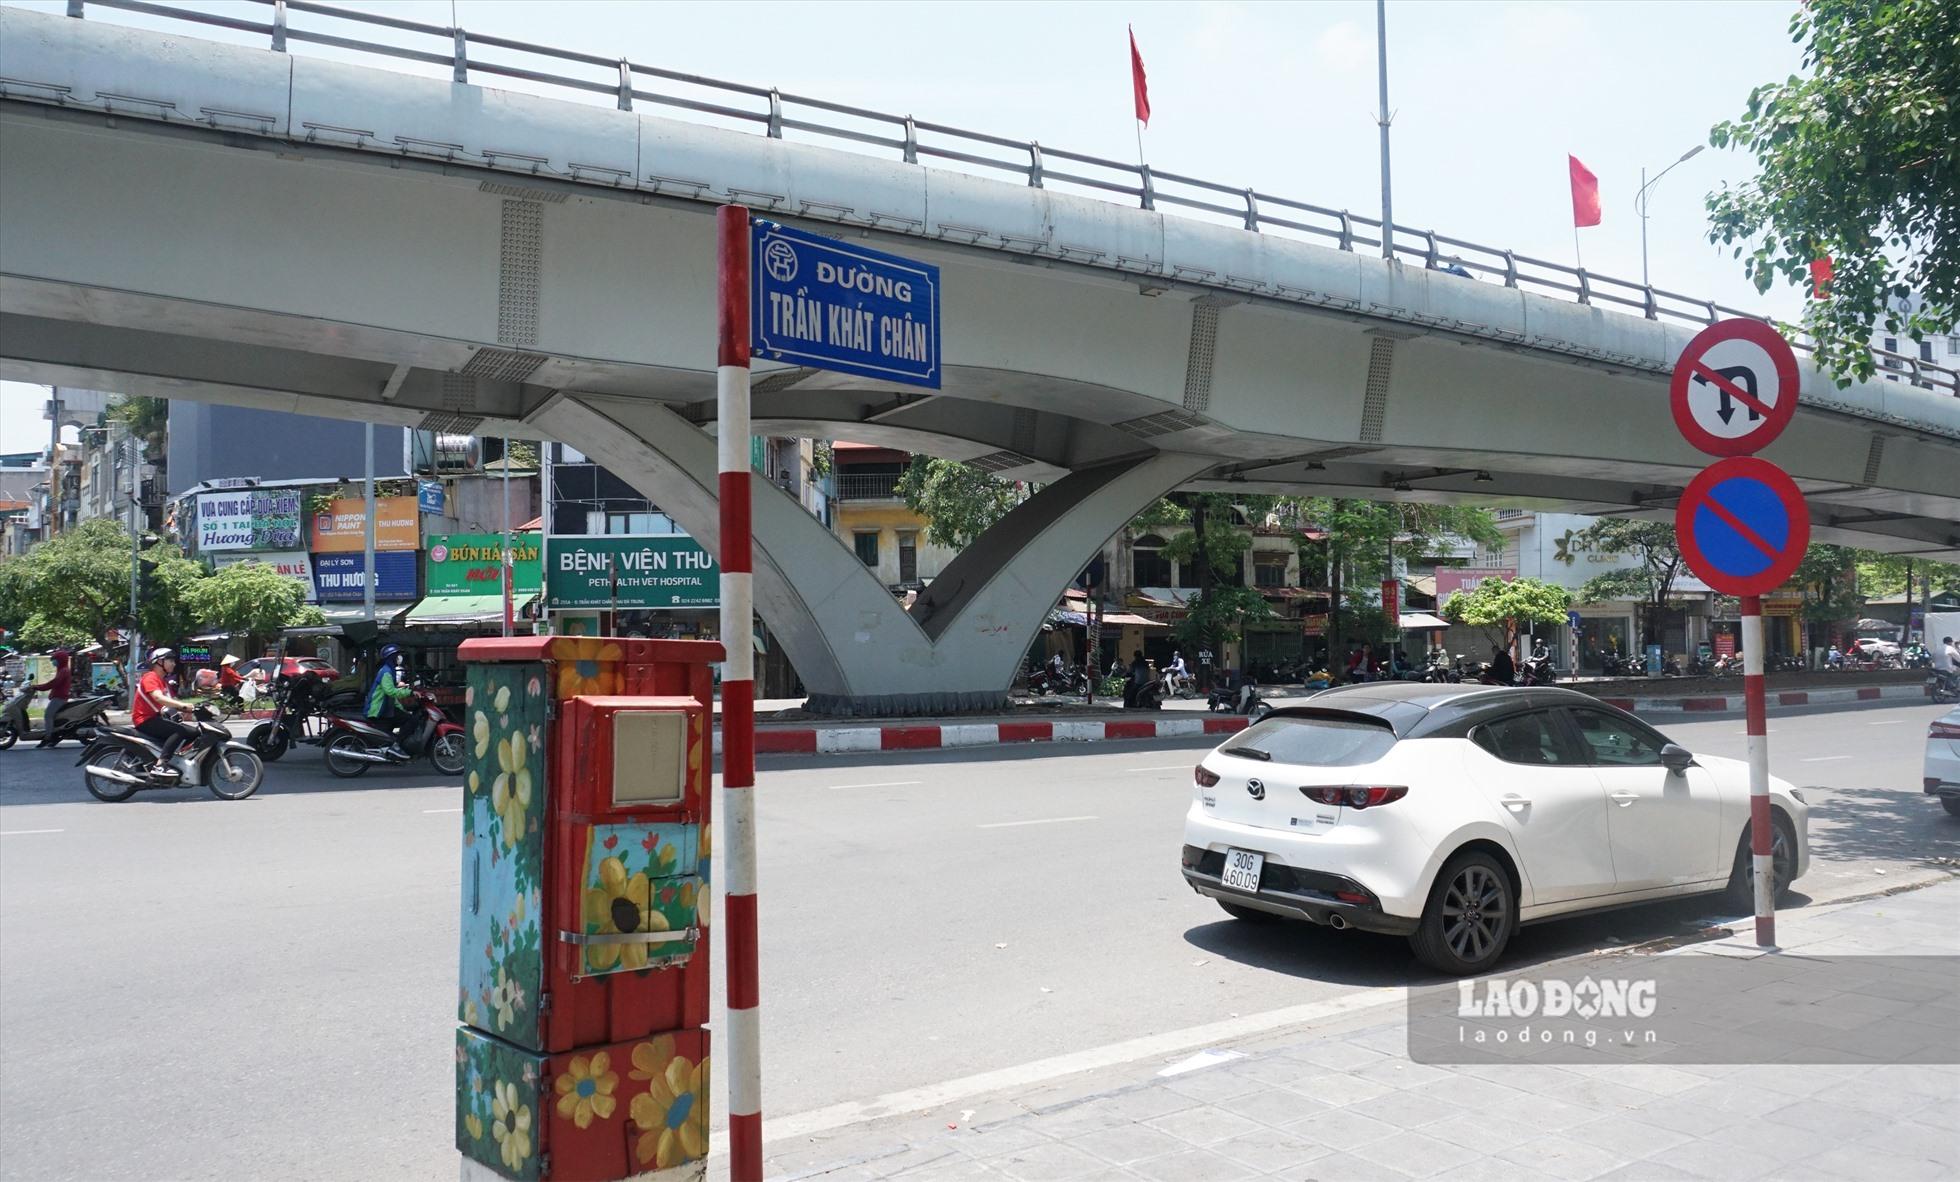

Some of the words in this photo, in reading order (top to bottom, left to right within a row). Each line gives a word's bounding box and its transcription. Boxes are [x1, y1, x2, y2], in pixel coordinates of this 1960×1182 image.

[817, 263, 912, 303] ĐƯỜNG
[769, 286, 822, 343] TRẦN
[828, 302, 874, 353] KHÁT
[880, 312, 927, 363] CHÂN
[222, 522, 228, 530] 1
[334, 513, 367, 522] NIPPON
[337, 521, 361, 530] PAINT
[450, 544, 479, 561] BÚN
[481, 542, 503, 561] HẢ
[511, 541, 538, 561] SẢN
[276, 562, 291, 575] ÁN
[621, 547, 667, 575] VIỆN
[319, 573, 340, 588] THU
[342, 571, 379, 588] HƯƠG
[588, 577, 640, 587] PETHALTH
[641, 577, 659, 587] VET
[660, 576, 702, 587] HOSPITAL
[1233, 852, 1254, 870] 30G
[1223, 870, 1258, 890] 460.09
